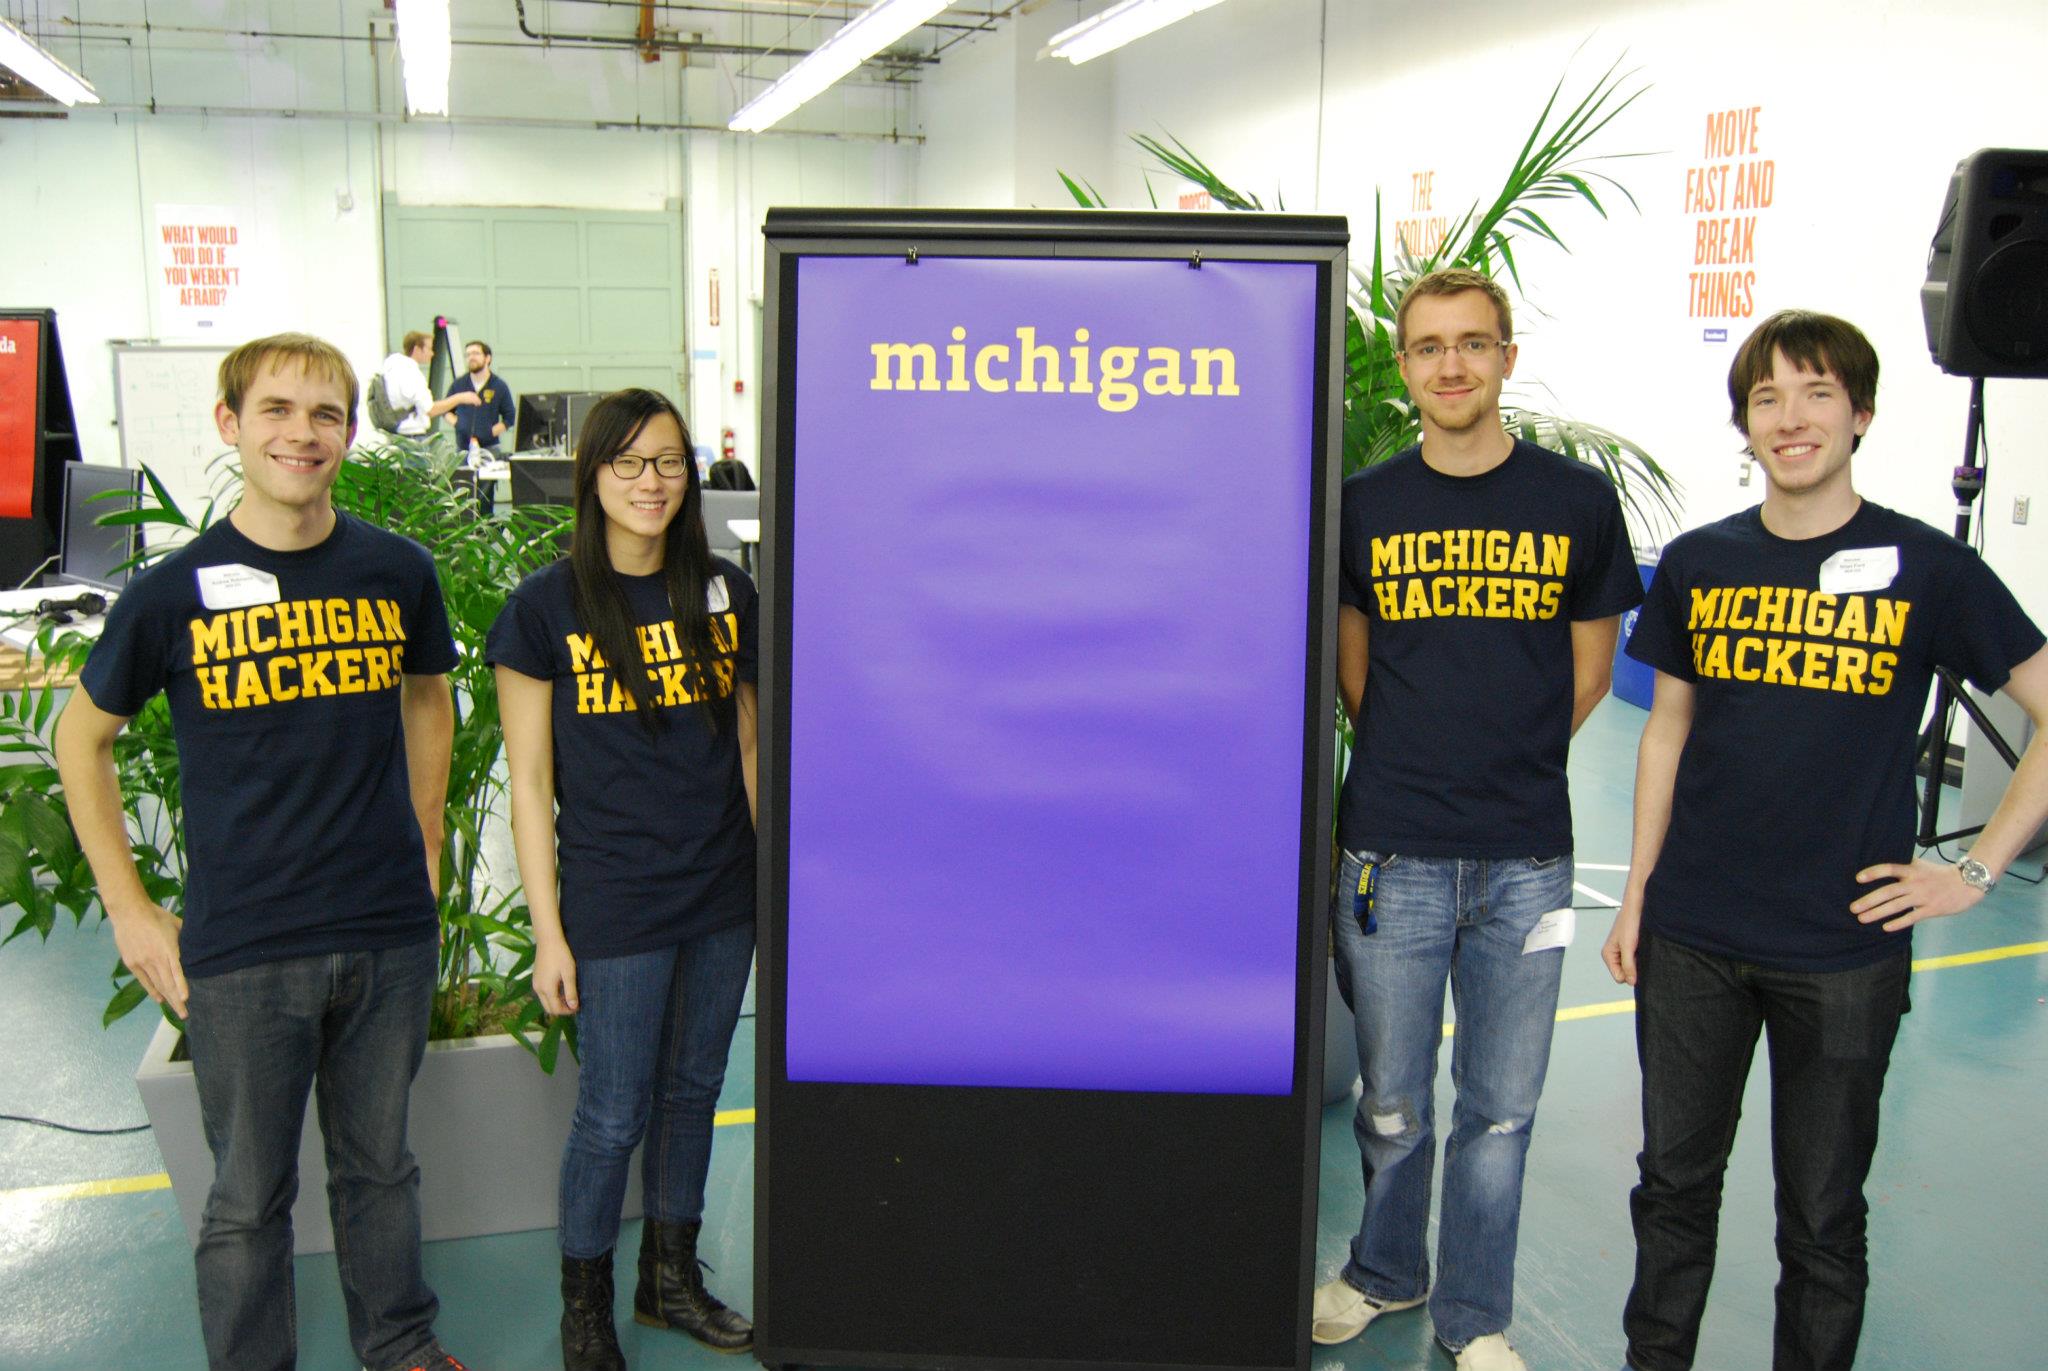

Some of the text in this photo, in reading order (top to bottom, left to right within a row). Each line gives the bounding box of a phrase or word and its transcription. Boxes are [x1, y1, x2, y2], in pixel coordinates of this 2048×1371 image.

[1704, 106, 1762, 160] MOVE
[1412, 171, 1435, 212] THE
[1684, 160, 1775, 214] FAST AND
[161, 225, 238, 246] WHAT WOULD
[173, 246, 227, 265] YOU DO IF
[1694, 216, 1757, 266] BREAK
[164, 267, 240, 286] YOU WEREN'T
[180, 288, 228, 306] AFRAID?
[1688, 270, 1756, 318] THINGS
[870, 326, 1240, 412] michigan
[1371, 530, 1570, 577] MICHIGAN
[1373, 576, 1564, 621] HACKERS
[1688, 586, 1911, 647] MICHIGAN
[190, 598, 407, 665] MICHIGAN
[196, 645, 404, 710] HACKERS
[1692, 633, 1898, 696] HACKERS
